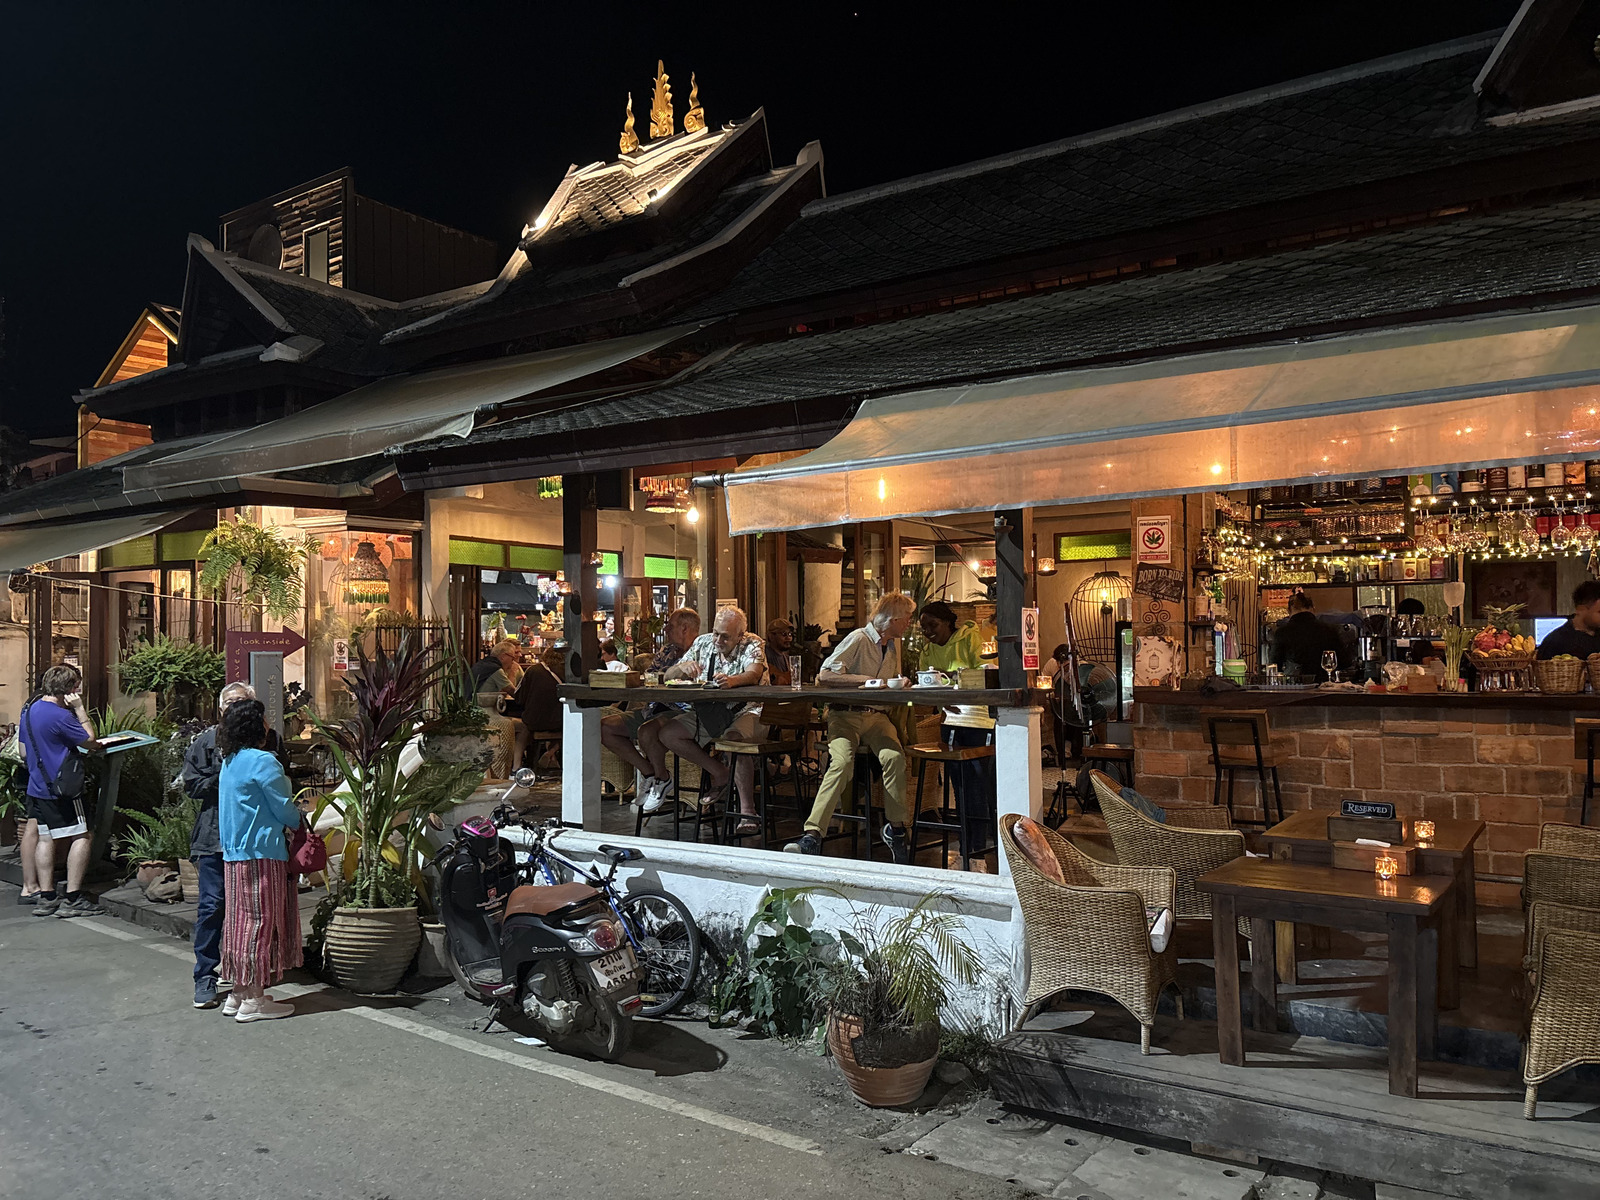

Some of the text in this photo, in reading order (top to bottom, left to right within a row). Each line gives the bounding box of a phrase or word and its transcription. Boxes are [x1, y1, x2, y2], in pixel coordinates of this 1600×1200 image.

[1137, 568, 1184, 584] BORN TO RIDE
[240, 637, 260, 645] look
[607, 971, 633, 990] 4687
